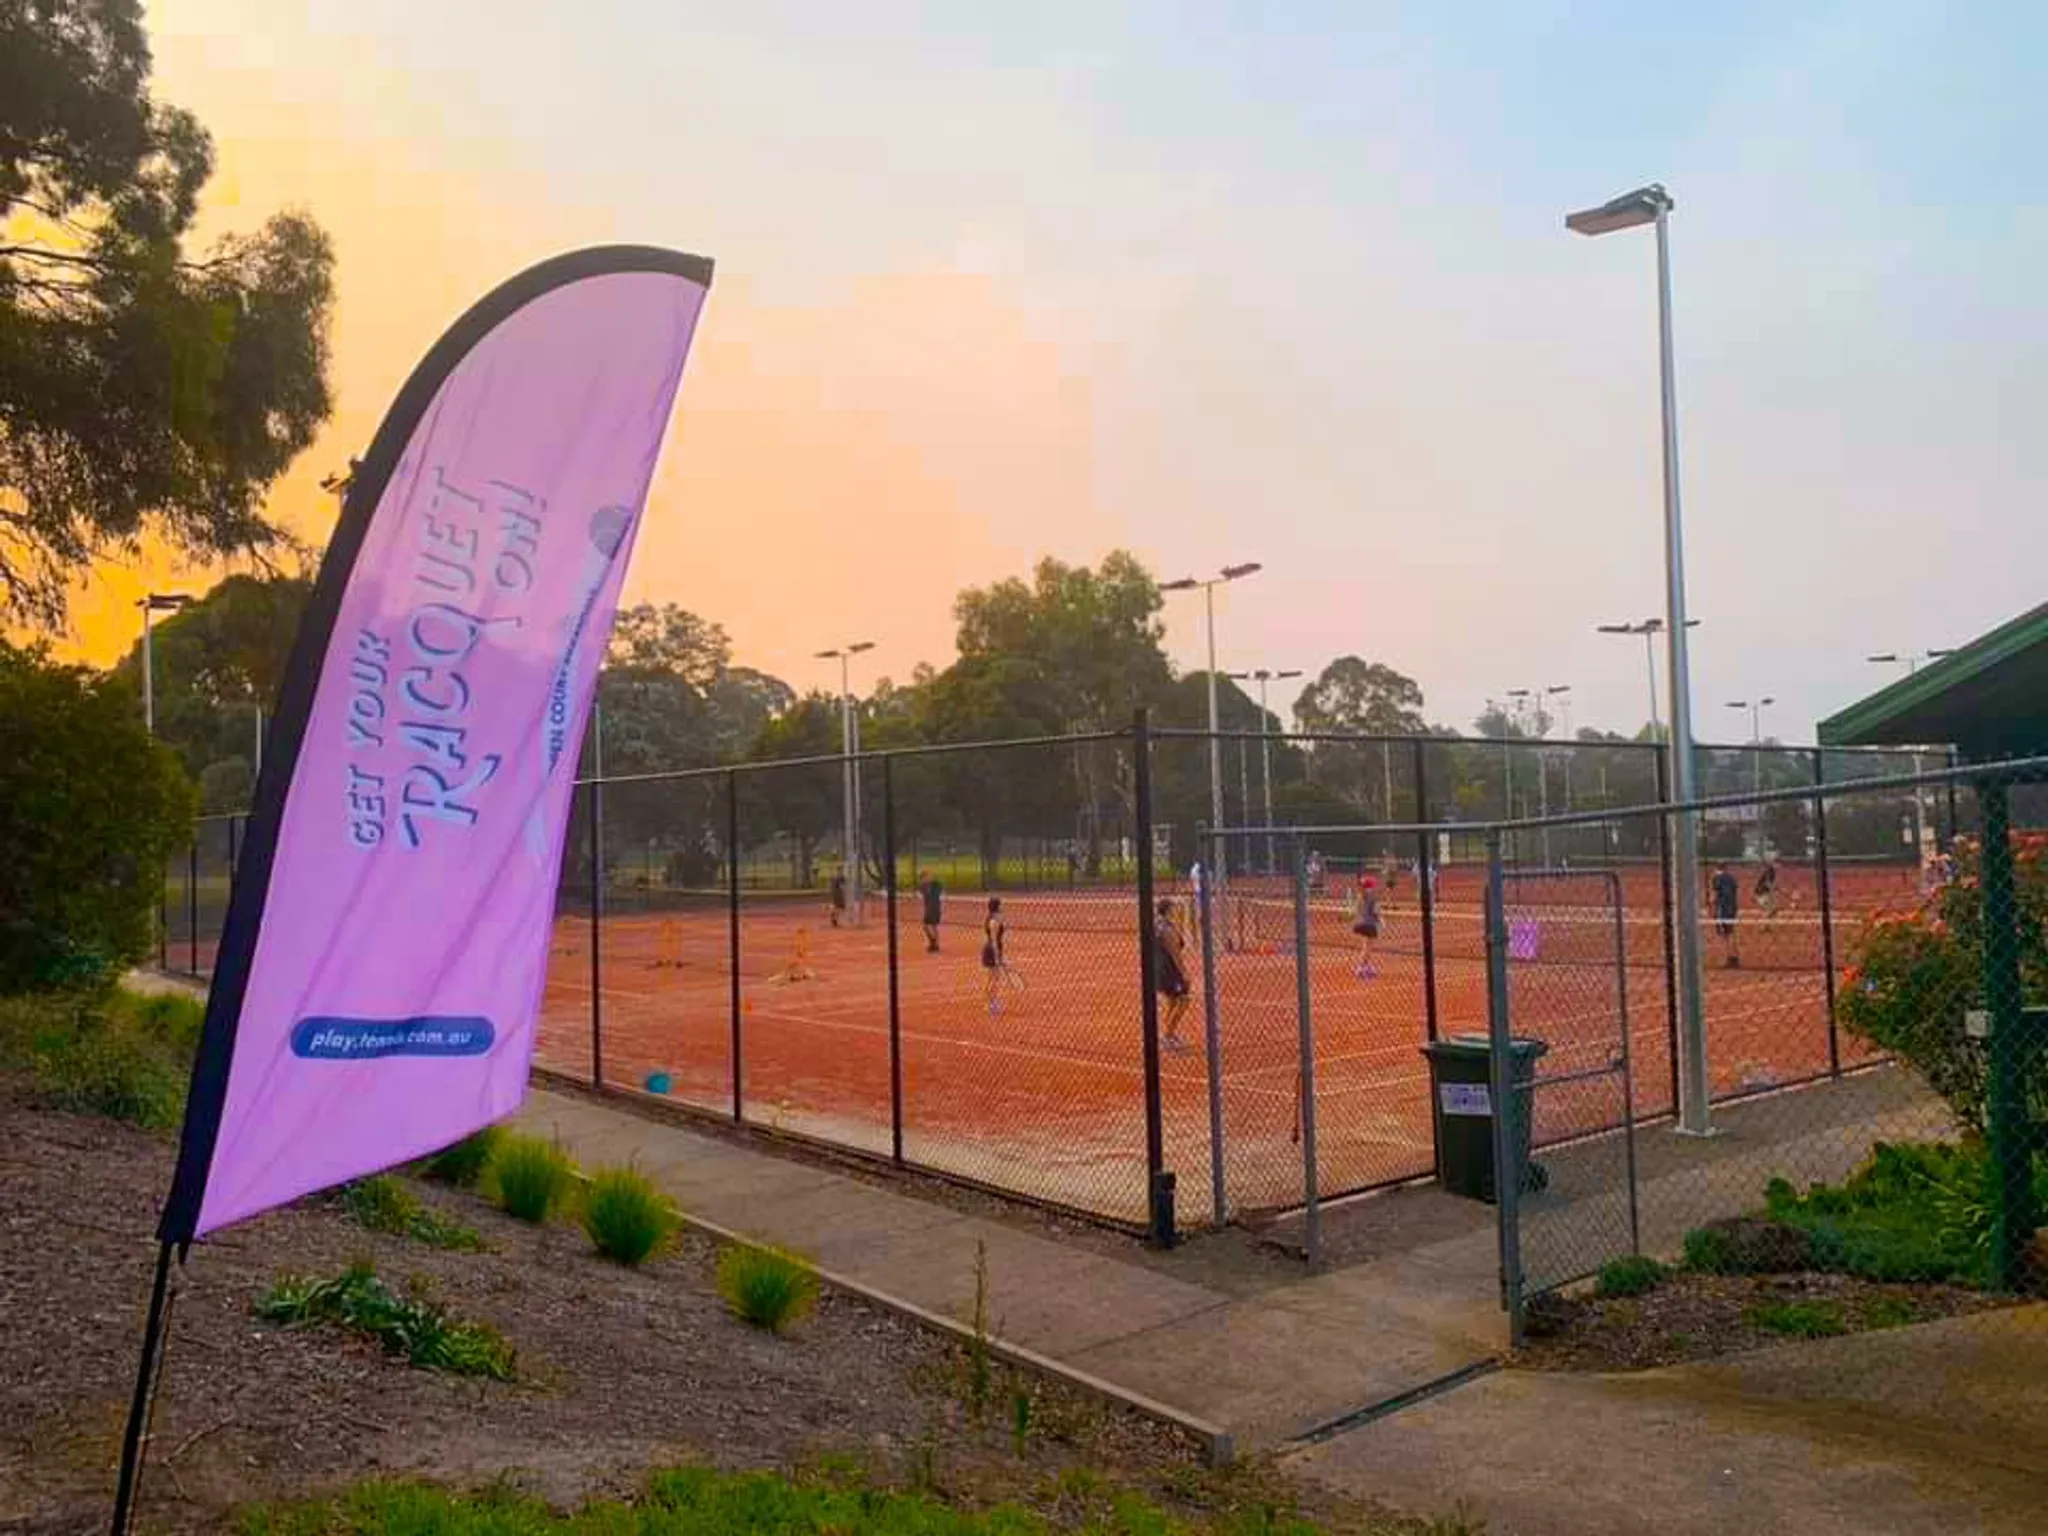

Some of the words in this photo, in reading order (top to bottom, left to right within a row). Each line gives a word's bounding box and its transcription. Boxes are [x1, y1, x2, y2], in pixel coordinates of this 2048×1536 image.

[490, 478, 549, 591] ON!
[348, 628, 392, 750] YOUR
[398, 464, 523, 848] RACQUET
[346, 762, 387, 846] GET
